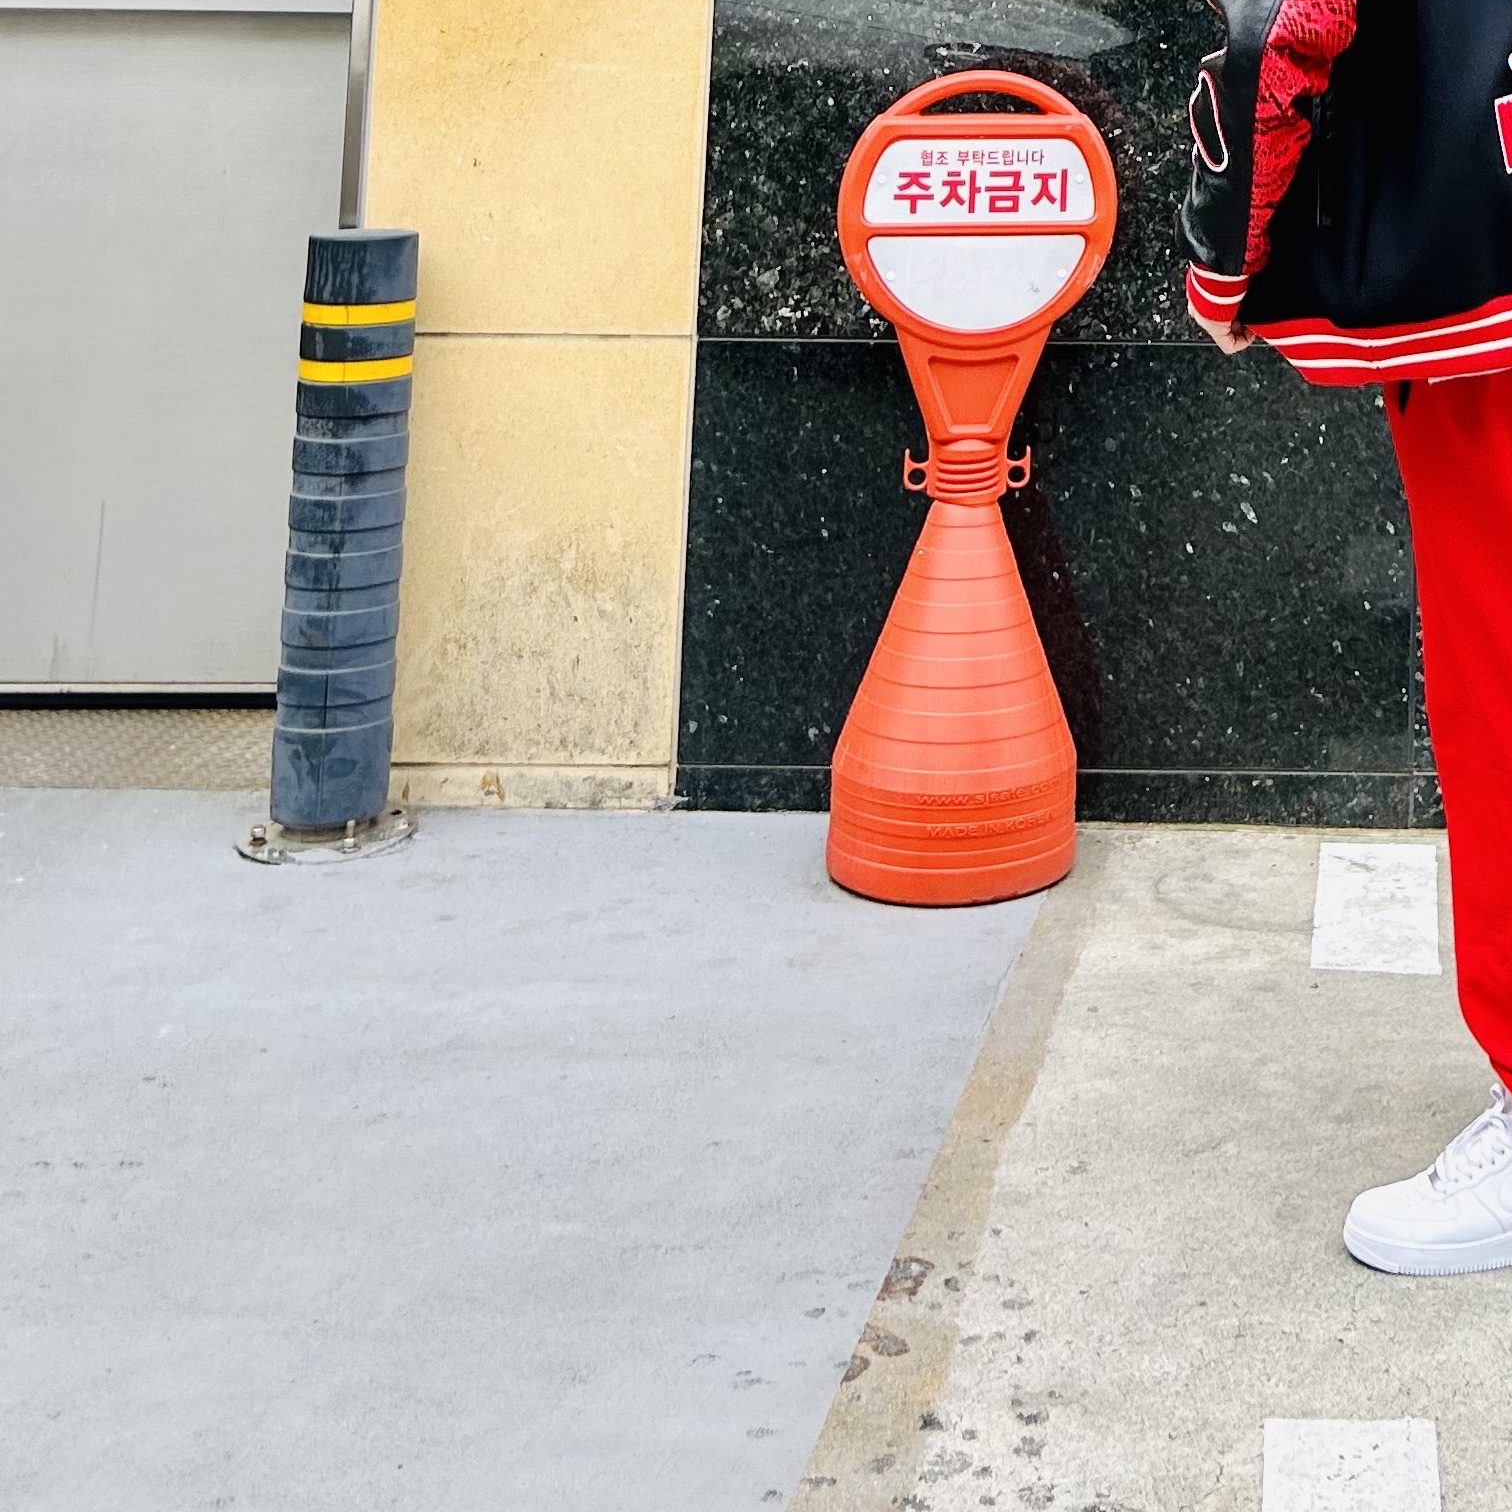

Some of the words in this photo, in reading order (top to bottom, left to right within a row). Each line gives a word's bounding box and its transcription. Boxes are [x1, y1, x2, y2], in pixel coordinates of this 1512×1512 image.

[920, 149, 949, 166] 협조
[957, 149, 1045, 166] 부탁드립니다
[893, 168, 1069, 214] 주차금지
[926, 824, 979, 837] MADE
[984, 822, 1001, 834] IN
